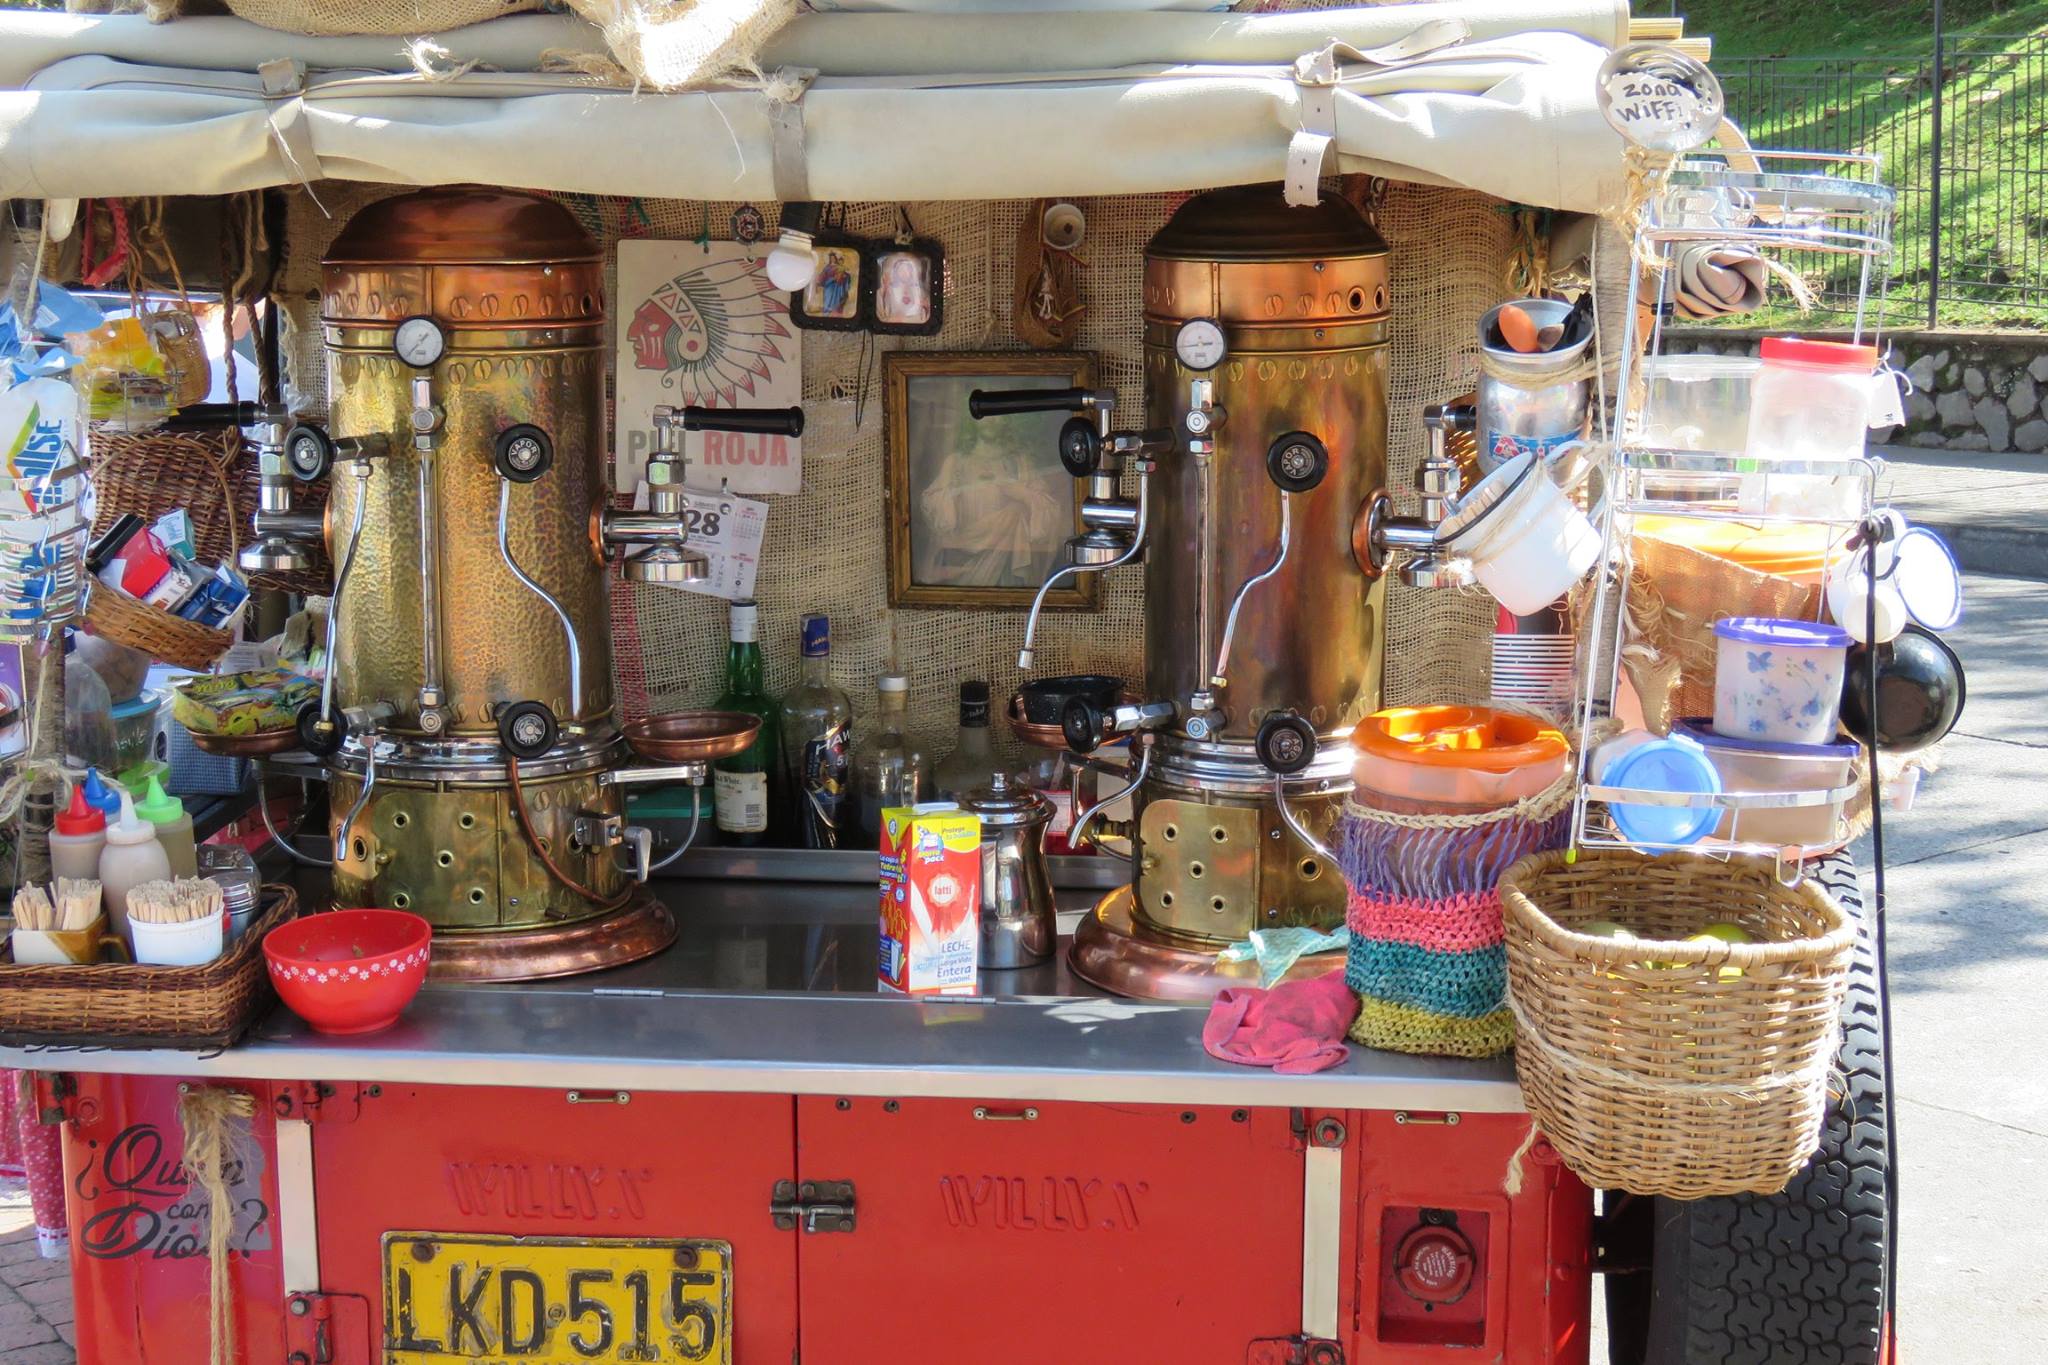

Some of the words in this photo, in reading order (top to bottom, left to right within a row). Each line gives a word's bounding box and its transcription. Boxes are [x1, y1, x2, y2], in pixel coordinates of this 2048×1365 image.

[510, 440, 537, 456] VAPOR
[628, 430, 693, 464] PIL
[704, 431, 788, 466] ROJA
[1283, 447, 1299, 476] VAPOR
[686, 509, 720, 536] 28
[934, 885, 952, 895] latti
[941, 939, 971, 953] LECHE
[937, 965, 971, 977] Entera
[75, 1124, 245, 1201] ¿Qun
[81, 1198, 268, 1259] Dio?
[398, 1265, 548, 1357] LKD
[565, 1270, 717, 1360] 515
